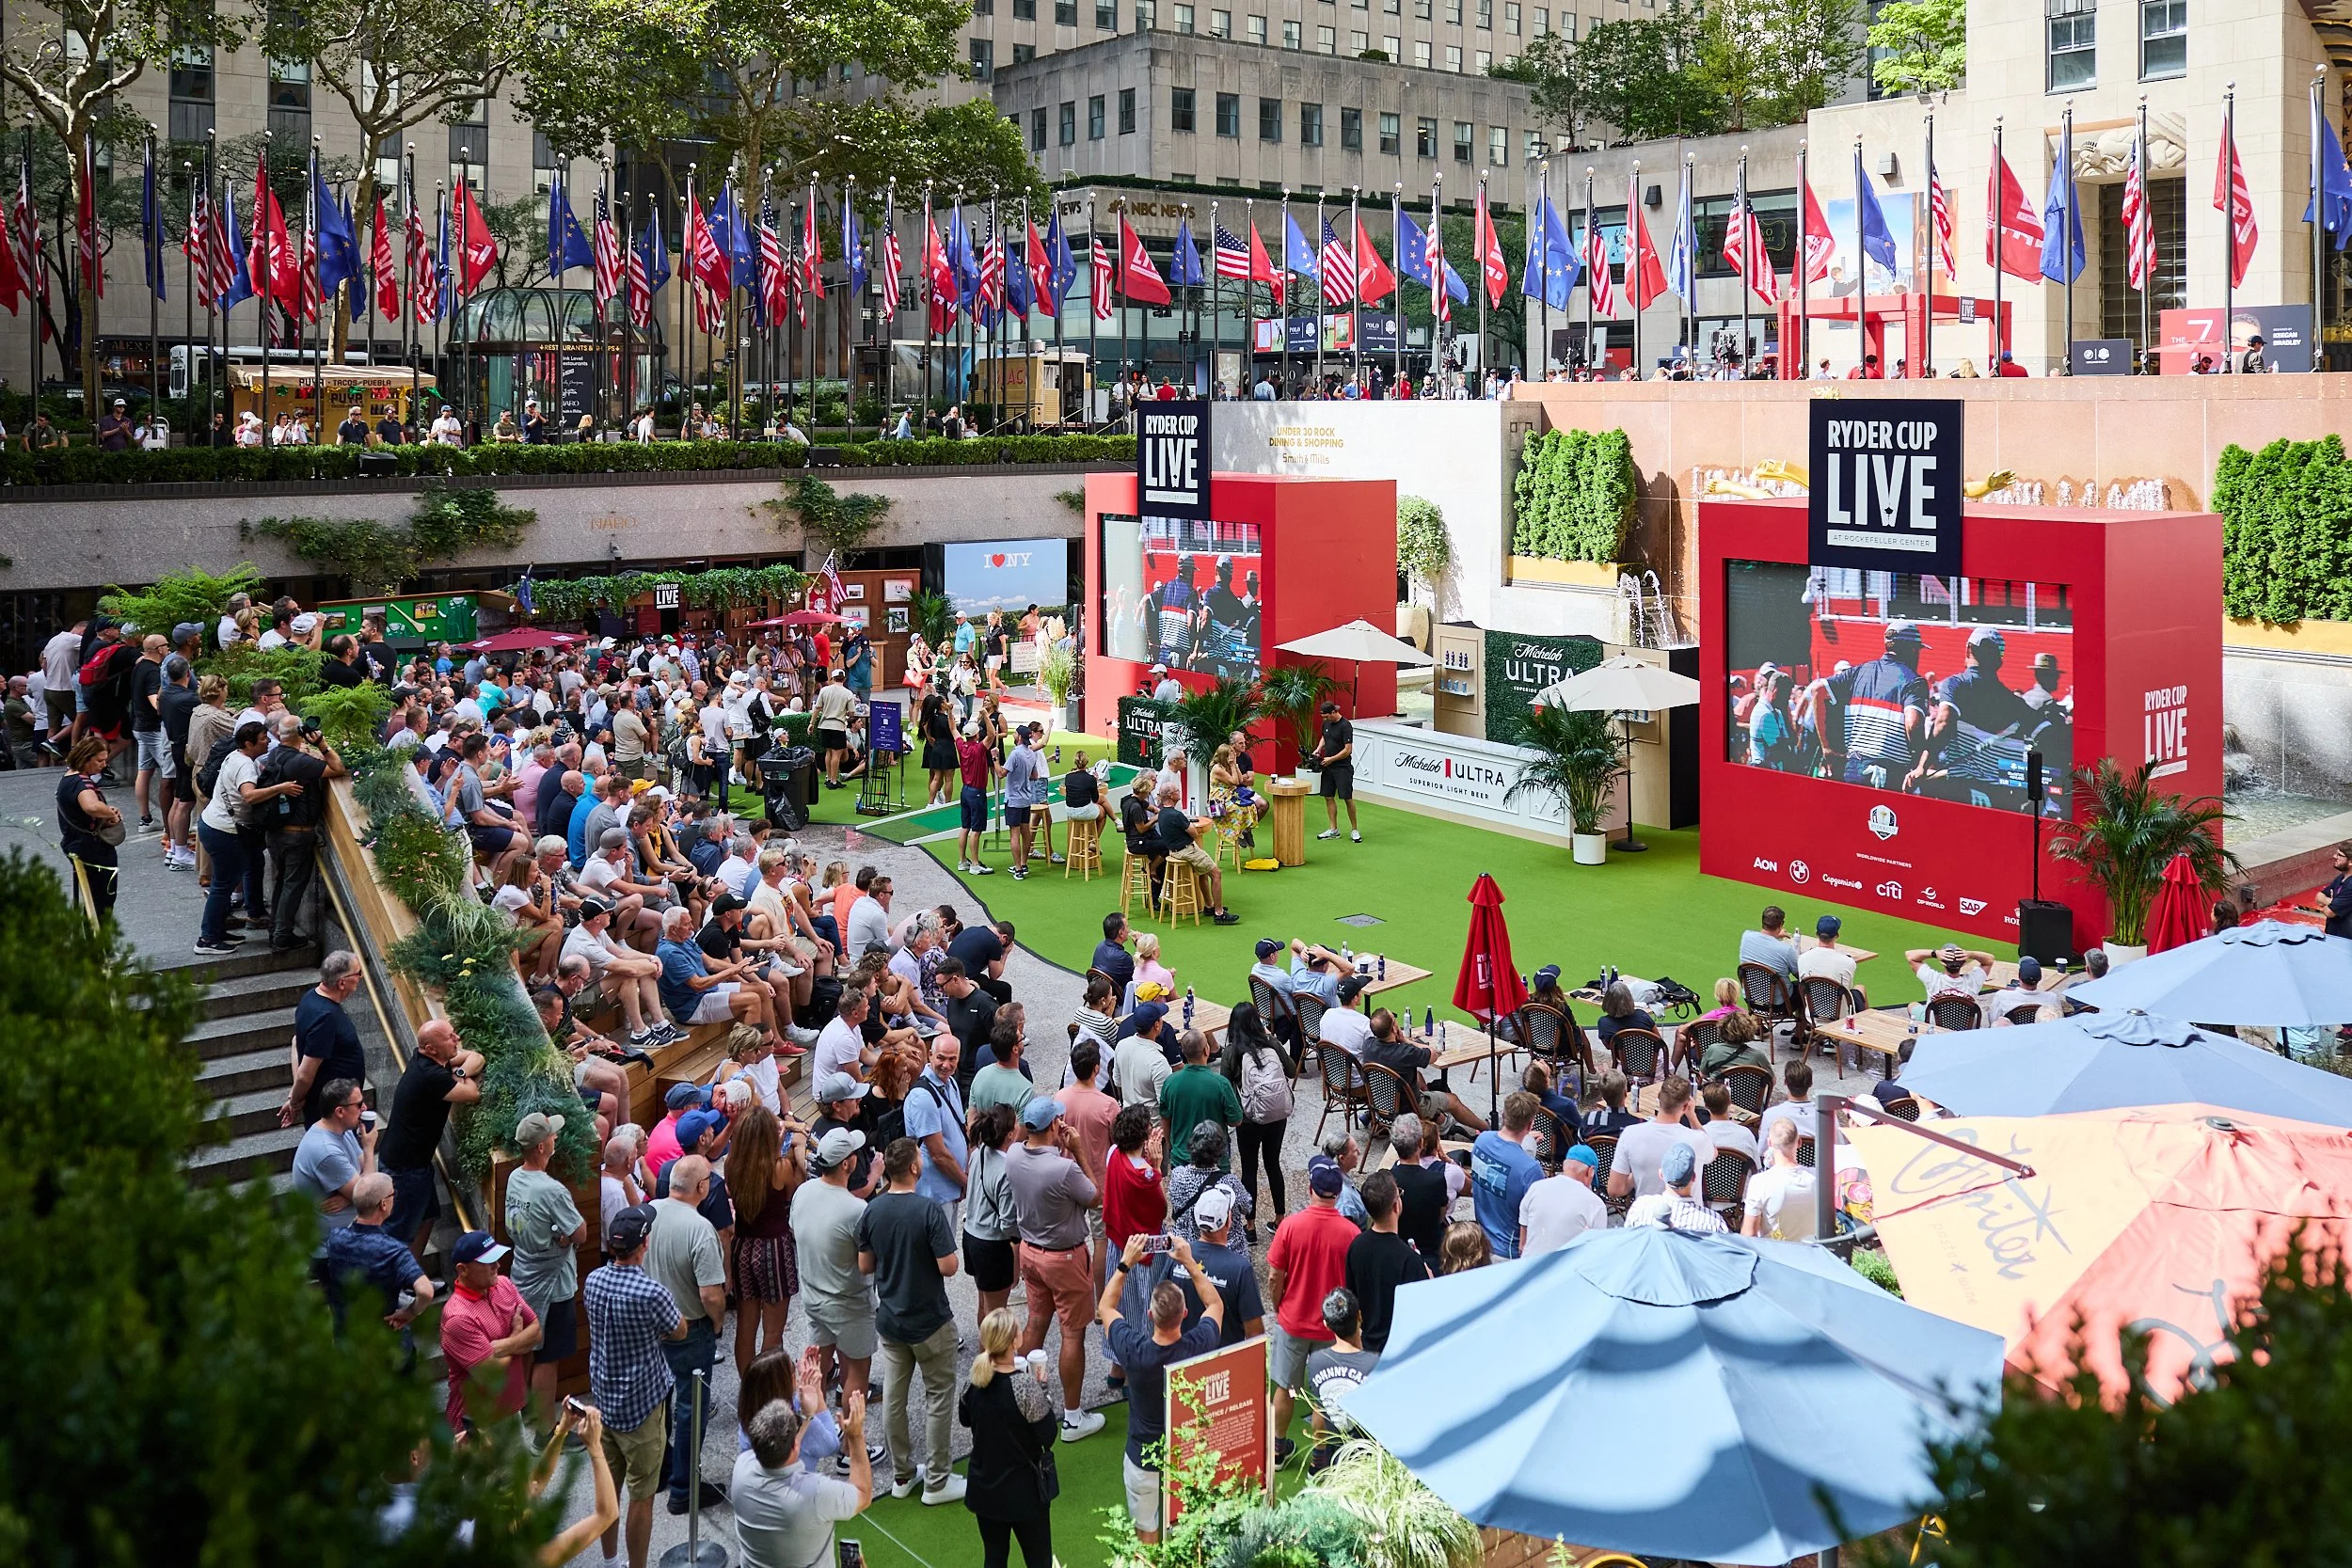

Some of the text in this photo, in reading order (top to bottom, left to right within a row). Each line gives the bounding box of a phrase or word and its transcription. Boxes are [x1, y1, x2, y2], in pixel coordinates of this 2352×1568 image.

[1131, 202, 1196, 219] NBC NEWS
[1962, 305, 1974, 317] LIVE
[2187, 319, 2213, 360] 7
[1268, 369, 1296, 380] POO
[331, 393, 363, 403] PUYA
[1145, 415, 1198, 435] RYDER CUP
[1277, 427, 1335, 437] UNDER 30 ROCK
[1269, 438, 1344, 448] DINING & SHOPPING
[1828, 420, 1937, 450] RYDER CUP
[1145, 438, 1198, 488] LIVE
[1283, 453, 1303, 463] Smith
[1310, 454, 1330, 464] Mills
[1828, 453, 1937, 529] LIVE
[1844, 535, 1897, 545] ROCKEFELLER
[984, 552, 1033, 568] I NY
[656, 591, 679, 605] LIVE
[1514, 643, 1564, 661] Michelob
[1506, 660, 1575, 685] ULTRA
[2145, 685, 2187, 711] RYDER CUP
[1126, 715, 1161, 734] ULTRA
[2145, 707, 2187, 764] LIVE
[1395, 752, 1505, 787] Michelob ULTRA
[1410, 778, 1489, 799] SUPERIOR LIGHT BEER
[1753, 857, 1778, 872] AON
[1856, 853, 1912, 868] WORLDWIDE PARTNERS
[1822, 873, 1855, 888] Capgemini
[1876, 882, 1902, 900] citi
[1926, 900, 1945, 909] WORLD
[1961, 901, 1980, 912] SAP
[2004, 916, 2020, 926] ROL
[1958, 1276, 1978, 1306] wine
[1312, 1367, 1368, 1387] JOHNNY CAS
[1206, 1377, 1230, 1401] LIVE
[1204, 1409, 1224, 1419] NOTICE
[1229, 1399, 1253, 1412] RELEASE
